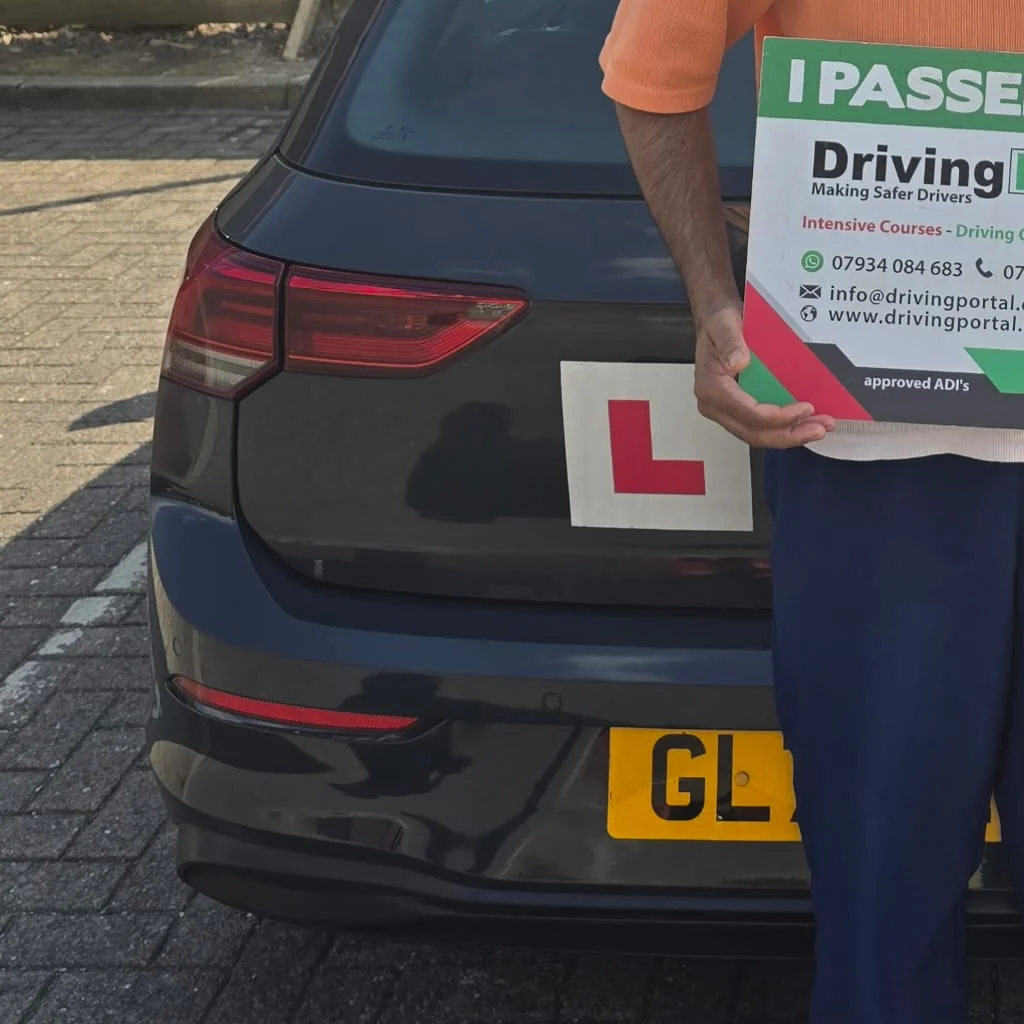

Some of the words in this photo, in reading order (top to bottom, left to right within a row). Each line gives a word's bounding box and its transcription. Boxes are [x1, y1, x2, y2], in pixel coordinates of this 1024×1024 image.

[788, 59, 806, 103] I
[811, 182, 869, 202] Making
[873, 185, 914, 201] Safer
[917, 188, 972, 204] Drivers
[802, 215, 876, 233] Intensive
[879, 219, 943, 237] Courses
[955, 223, 1015, 245] Driving
[831, 255, 888, 274] 07934
[892, 258, 926, 275] 084
[930, 260, 963, 278] 683
[863, 375, 932, 392] approved
[934, 378, 970, 392] ADI's
[608, 400, 706, 494] L
[651, 733, 796, 822] GL
